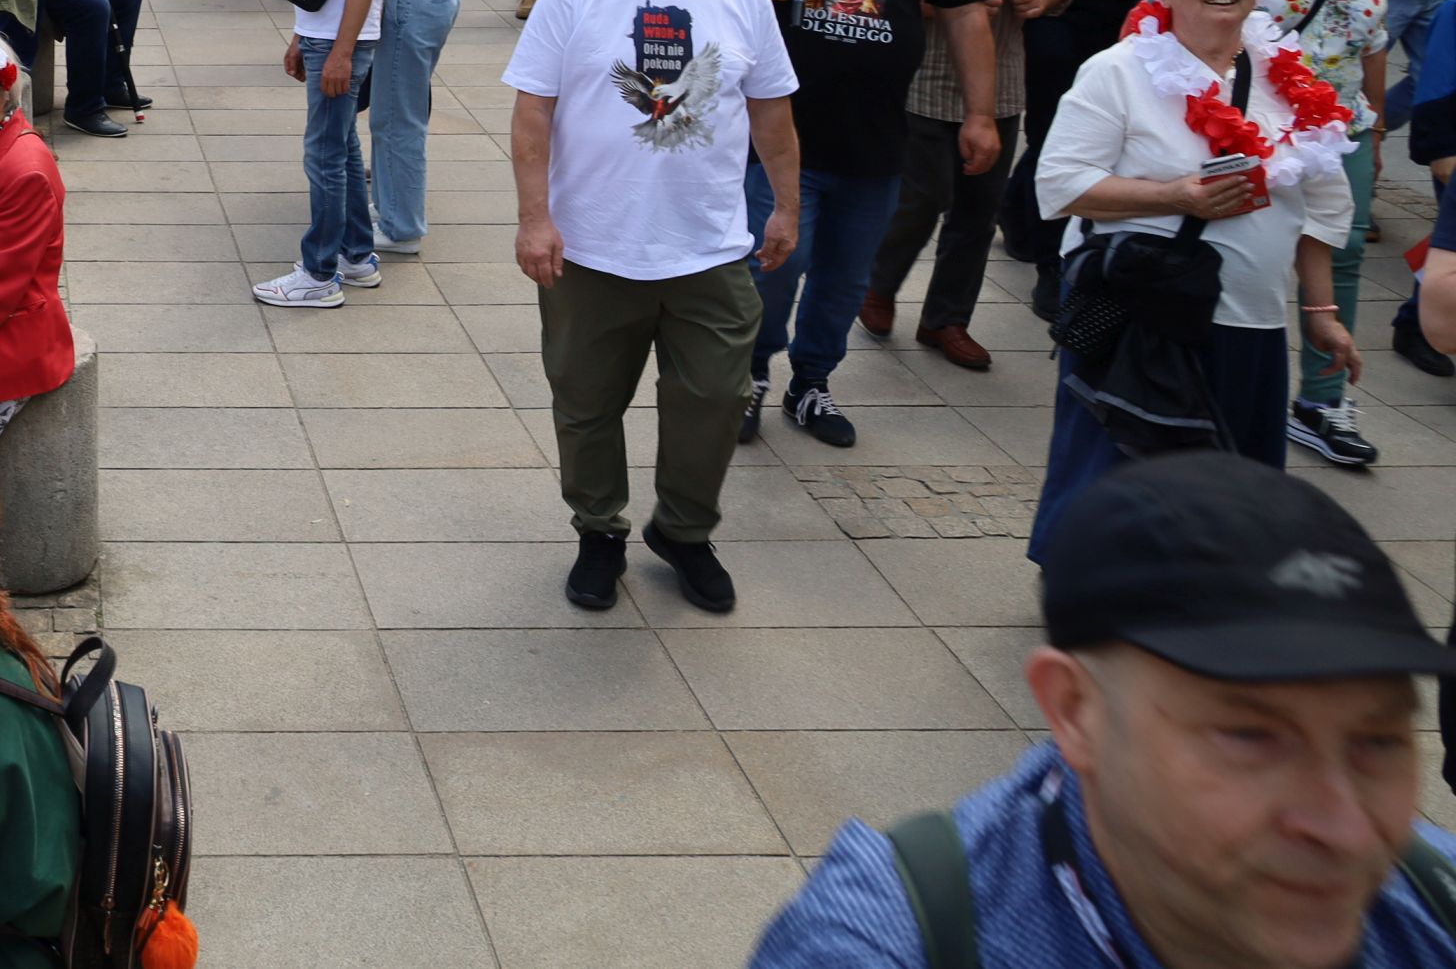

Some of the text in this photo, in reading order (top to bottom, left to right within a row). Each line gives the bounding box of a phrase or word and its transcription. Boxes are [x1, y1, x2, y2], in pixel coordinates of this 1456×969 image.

[643, 13, 669, 24] Ruda
[804, 7, 892, 31] RÓLESTWA
[644, 43, 684, 56] Orła nie
[644, 58, 682, 71] pokona
